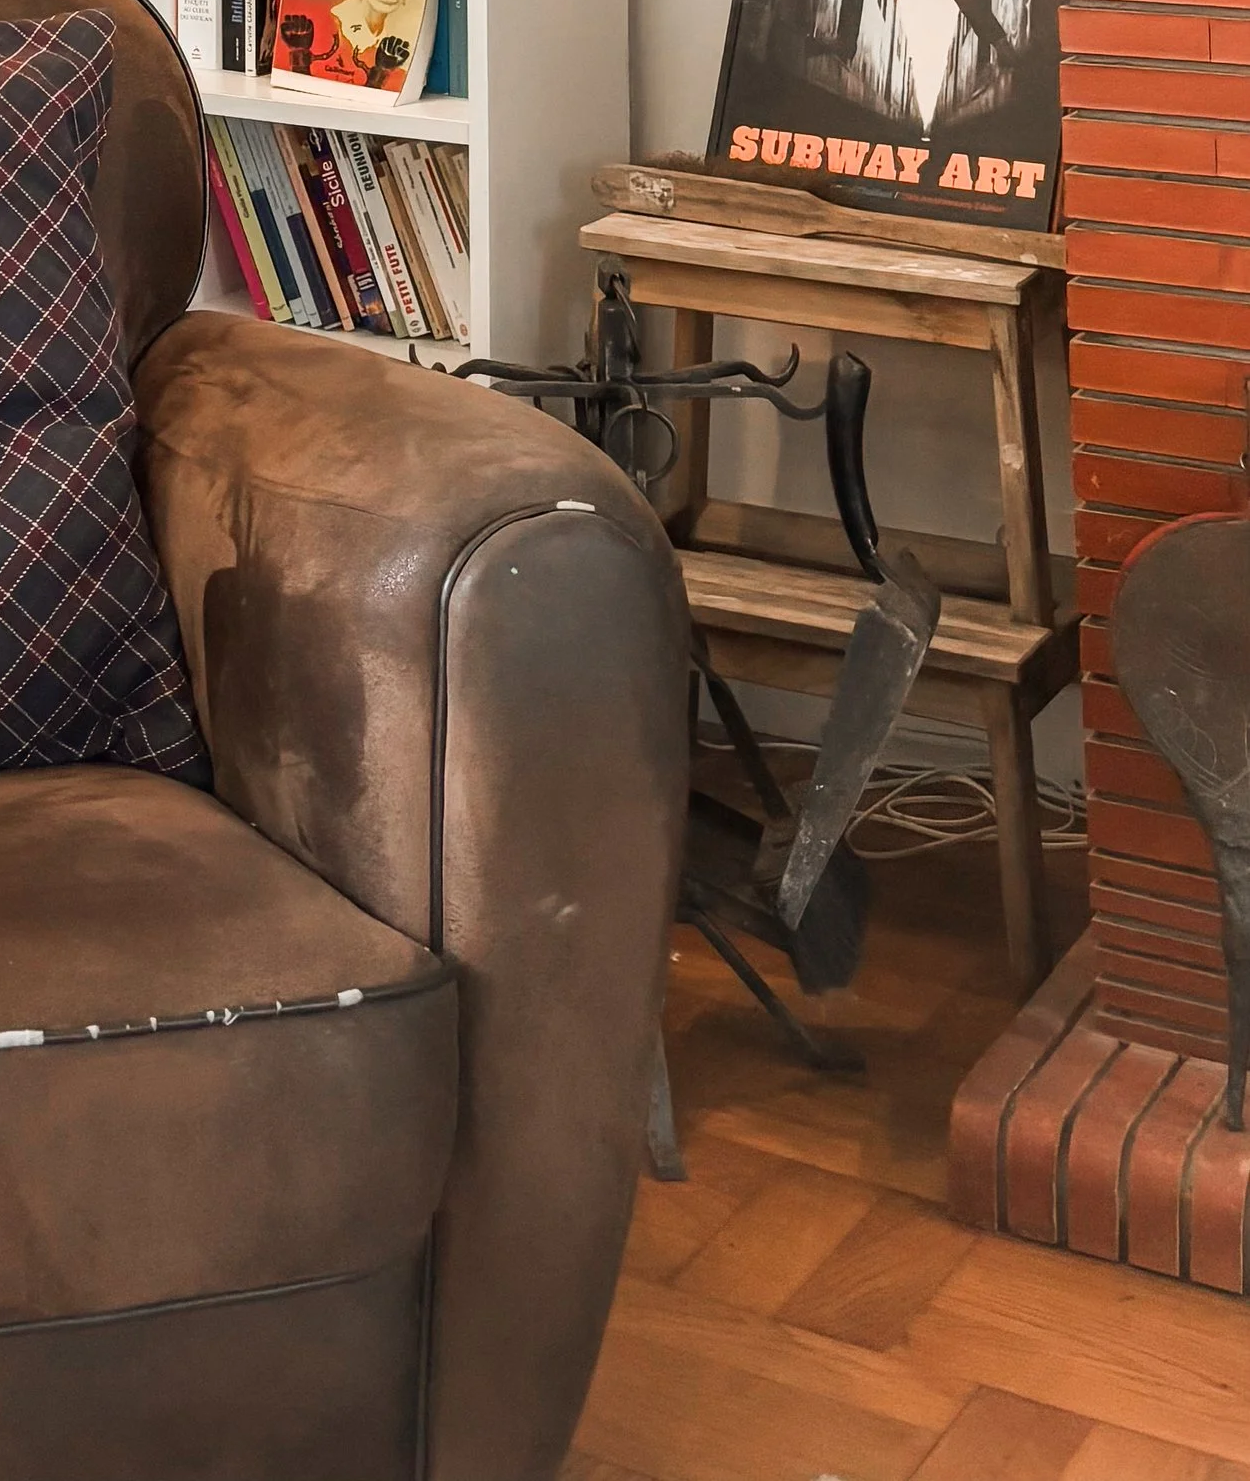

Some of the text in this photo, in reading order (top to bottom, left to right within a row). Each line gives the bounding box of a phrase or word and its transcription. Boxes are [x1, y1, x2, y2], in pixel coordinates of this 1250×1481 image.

[321, 160, 346, 208] Sicile
[728, 125, 930, 184] SUBWAY
[938, 153, 1046, 200] ART
[395, 279, 416, 316] PETIT
